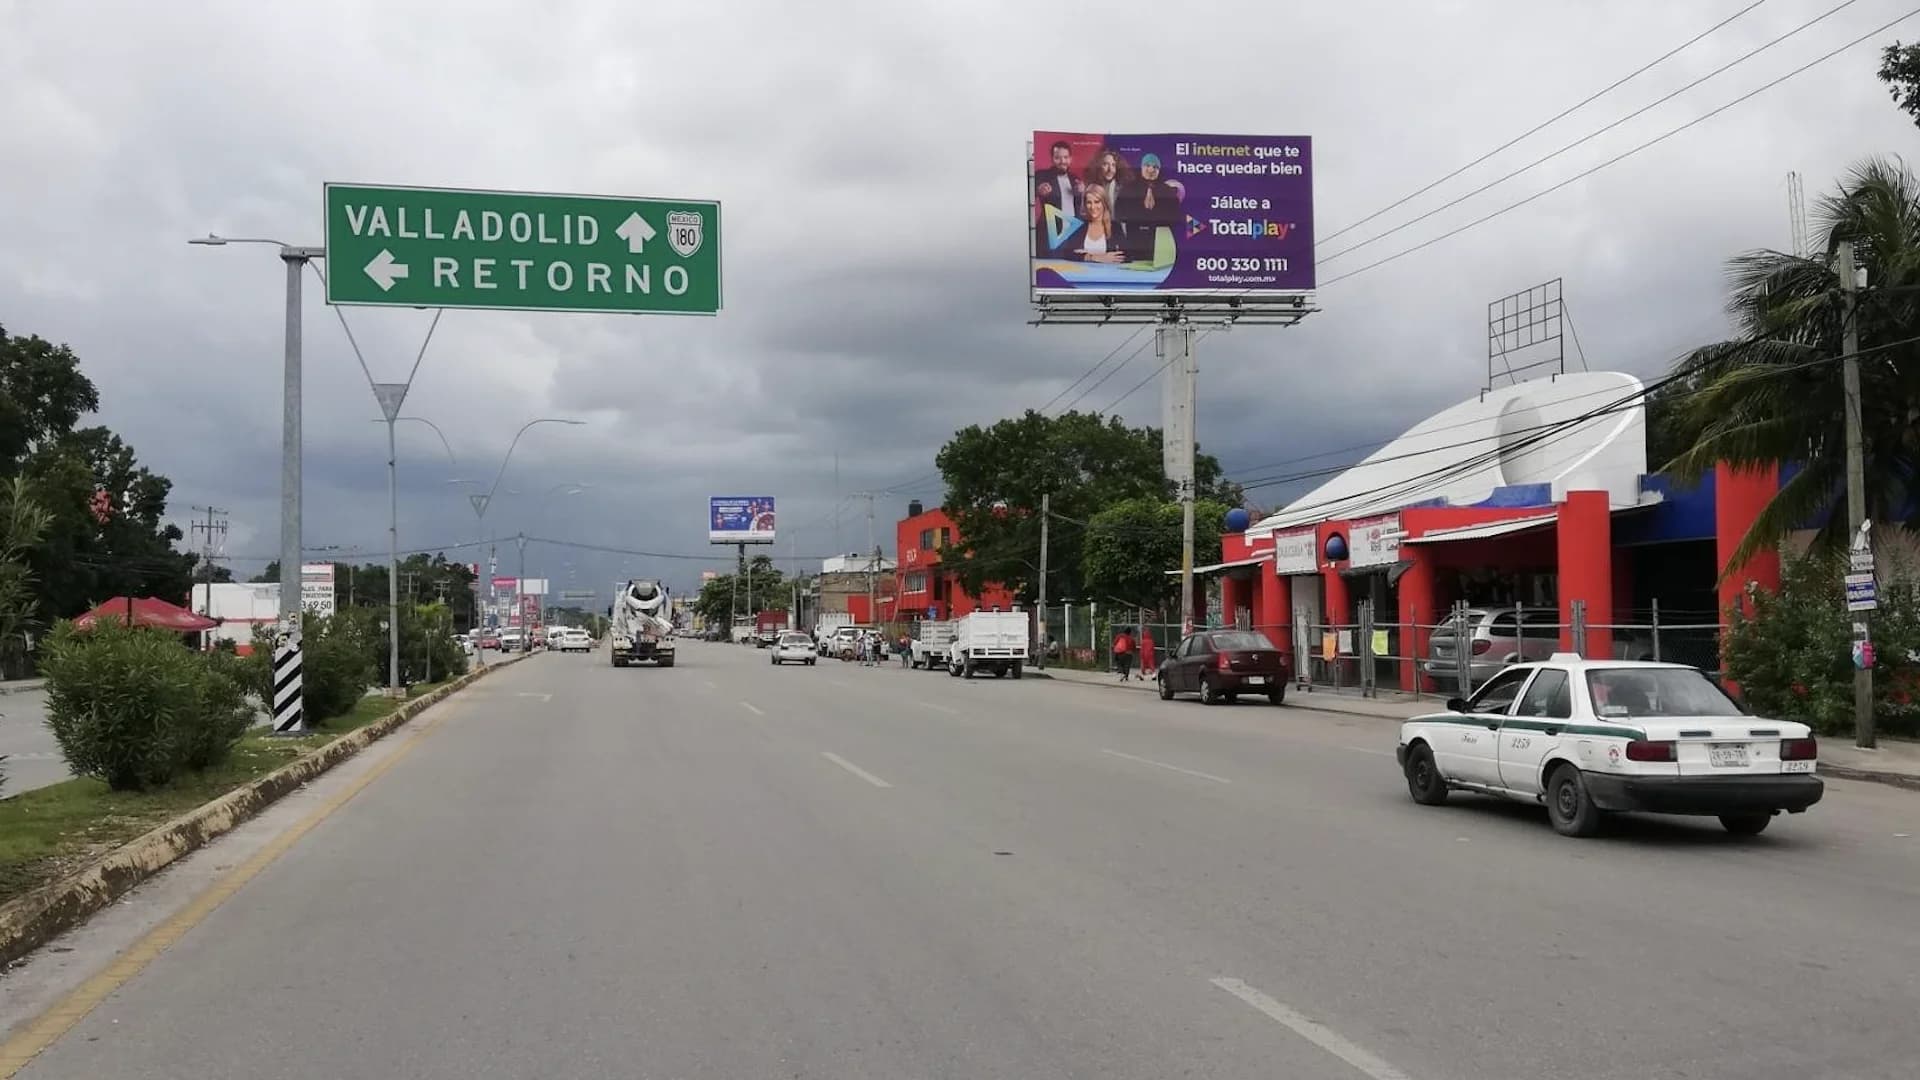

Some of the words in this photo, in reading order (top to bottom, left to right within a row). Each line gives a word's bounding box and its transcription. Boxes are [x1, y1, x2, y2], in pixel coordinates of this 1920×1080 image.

[1175, 143, 1190, 156] El
[1193, 143, 1251, 157] internet
[1253, 147, 1282, 160] que
[1284, 145, 1300, 157] te
[1177, 160, 1213, 174] hace
[1215, 162, 1267, 177] quedar
[1270, 161, 1303, 175] bien
[1211, 195, 1258, 209] Jálate
[1261, 199, 1272, 209] a
[344, 204, 599, 246] VALLADOLID
[1208, 218, 1289, 240] Totalplay
[676, 228, 696, 246] 180
[1196, 258, 1228, 271] 800
[1231, 258, 1261, 271] 330
[1264, 258, 1288, 271] 1111
[433, 256, 690, 296] RETORNO
[1208, 274, 1276, 284] totalplay.com.mx
